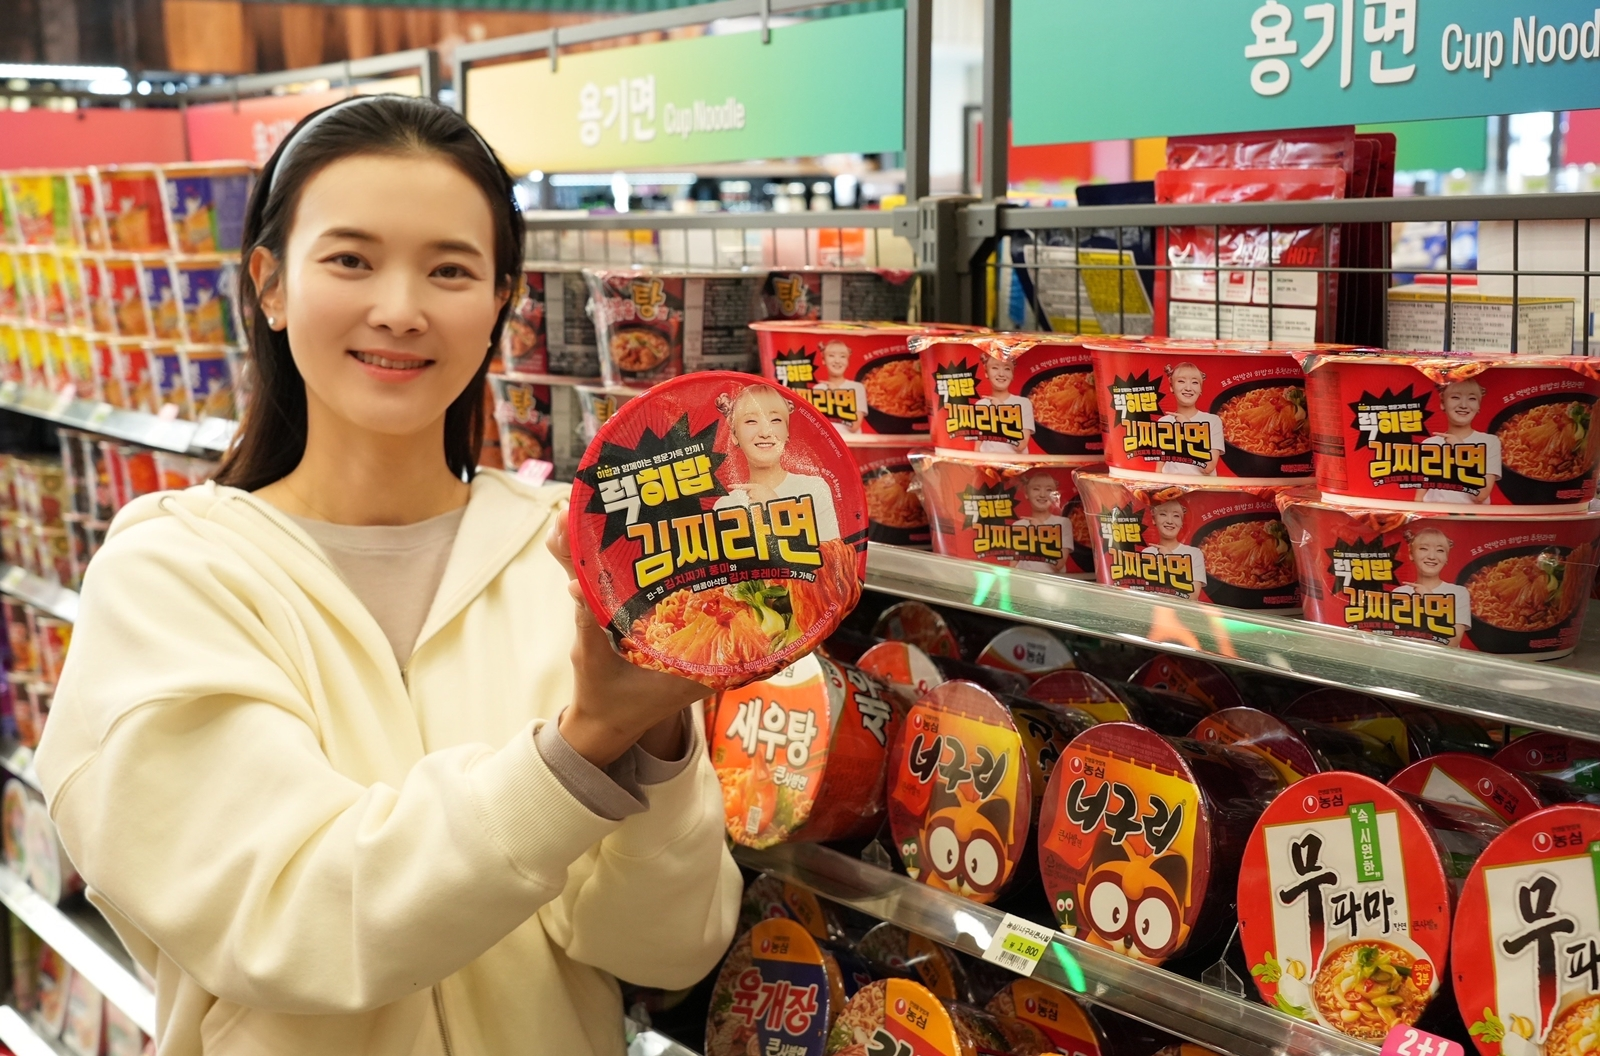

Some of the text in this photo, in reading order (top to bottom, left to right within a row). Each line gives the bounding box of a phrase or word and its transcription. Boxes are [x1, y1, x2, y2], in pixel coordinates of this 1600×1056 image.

[1244, 0, 1416, 96] 용기면
[1441, 23, 1504, 79] Cup
[577, 75, 656, 147] 용기면
[664, 96, 747, 140] Cup Noodle
[1287, 247, 1319, 265] HOT
[632, 279, 666, 319] 탕
[776, 363, 813, 387] 럭히밥
[1220, 378, 1233, 388] 프로
[937, 377, 976, 404] 럭히밥
[1502, 395, 1516, 404] 프로
[793, 388, 858, 421] 찌라면
[1113, 392, 1158, 419] 럭히밥
[944, 403, 1024, 440] 김찌라면
[1358, 409, 1424, 441] 럭히밥
[1121, 419, 1212, 461] 김찌라면
[596, 464, 621, 479] 히밥과
[621, 458, 653, 473] 함께하는
[652, 448, 684, 464] 행운가득
[1368, 440, 1487, 488] 김찌라면
[598, 454, 715, 526] 럭히밥
[963, 499, 1013, 524] 럭히밥
[1201, 512, 1213, 521] 프로
[626, 495, 823, 589] 김찌라면
[972, 523, 1063, 558] 김찌라면
[1100, 521, 1142, 548] 럭히밥
[1470, 546, 1485, 556] 프로
[646, 562, 738, 601] 진-한 김치찌개 풍미와
[692, 567, 816, 592] 매콤아삭한 김치 후레이크가 가득!
[1108, 547, 1194, 592] 김찌라면
[1333, 558, 1394, 587] 럭히밥
[1343, 586, 1456, 637] 김찌라면
[1026, 647, 1047, 666] 농심
[725, 697, 819, 768] 새우탕
[923, 721, 939, 734] 농심
[773, 765, 809, 791] 큰사발면
[908, 733, 1008, 801] 너구리
[1083, 763, 1106, 779] 농심
[1319, 794, 1344, 810] 농심
[1492, 789, 1517, 815] 농심
[1066, 777, 1183, 856] 너구리
[1553, 831, 1583, 848] 농심
[1279, 833, 1395, 980] 무파마
[771, 940, 789, 955] 농심
[1017, 942, 1040, 957] 1,800
[1416, 972, 1430, 986] 3분
[731, 967, 819, 1037] 육개장
[1038, 1003, 1058, 1023] 농심
[906, 1007, 928, 1031] 농심
[1396, 1029, 1450, 1056] 2+1
